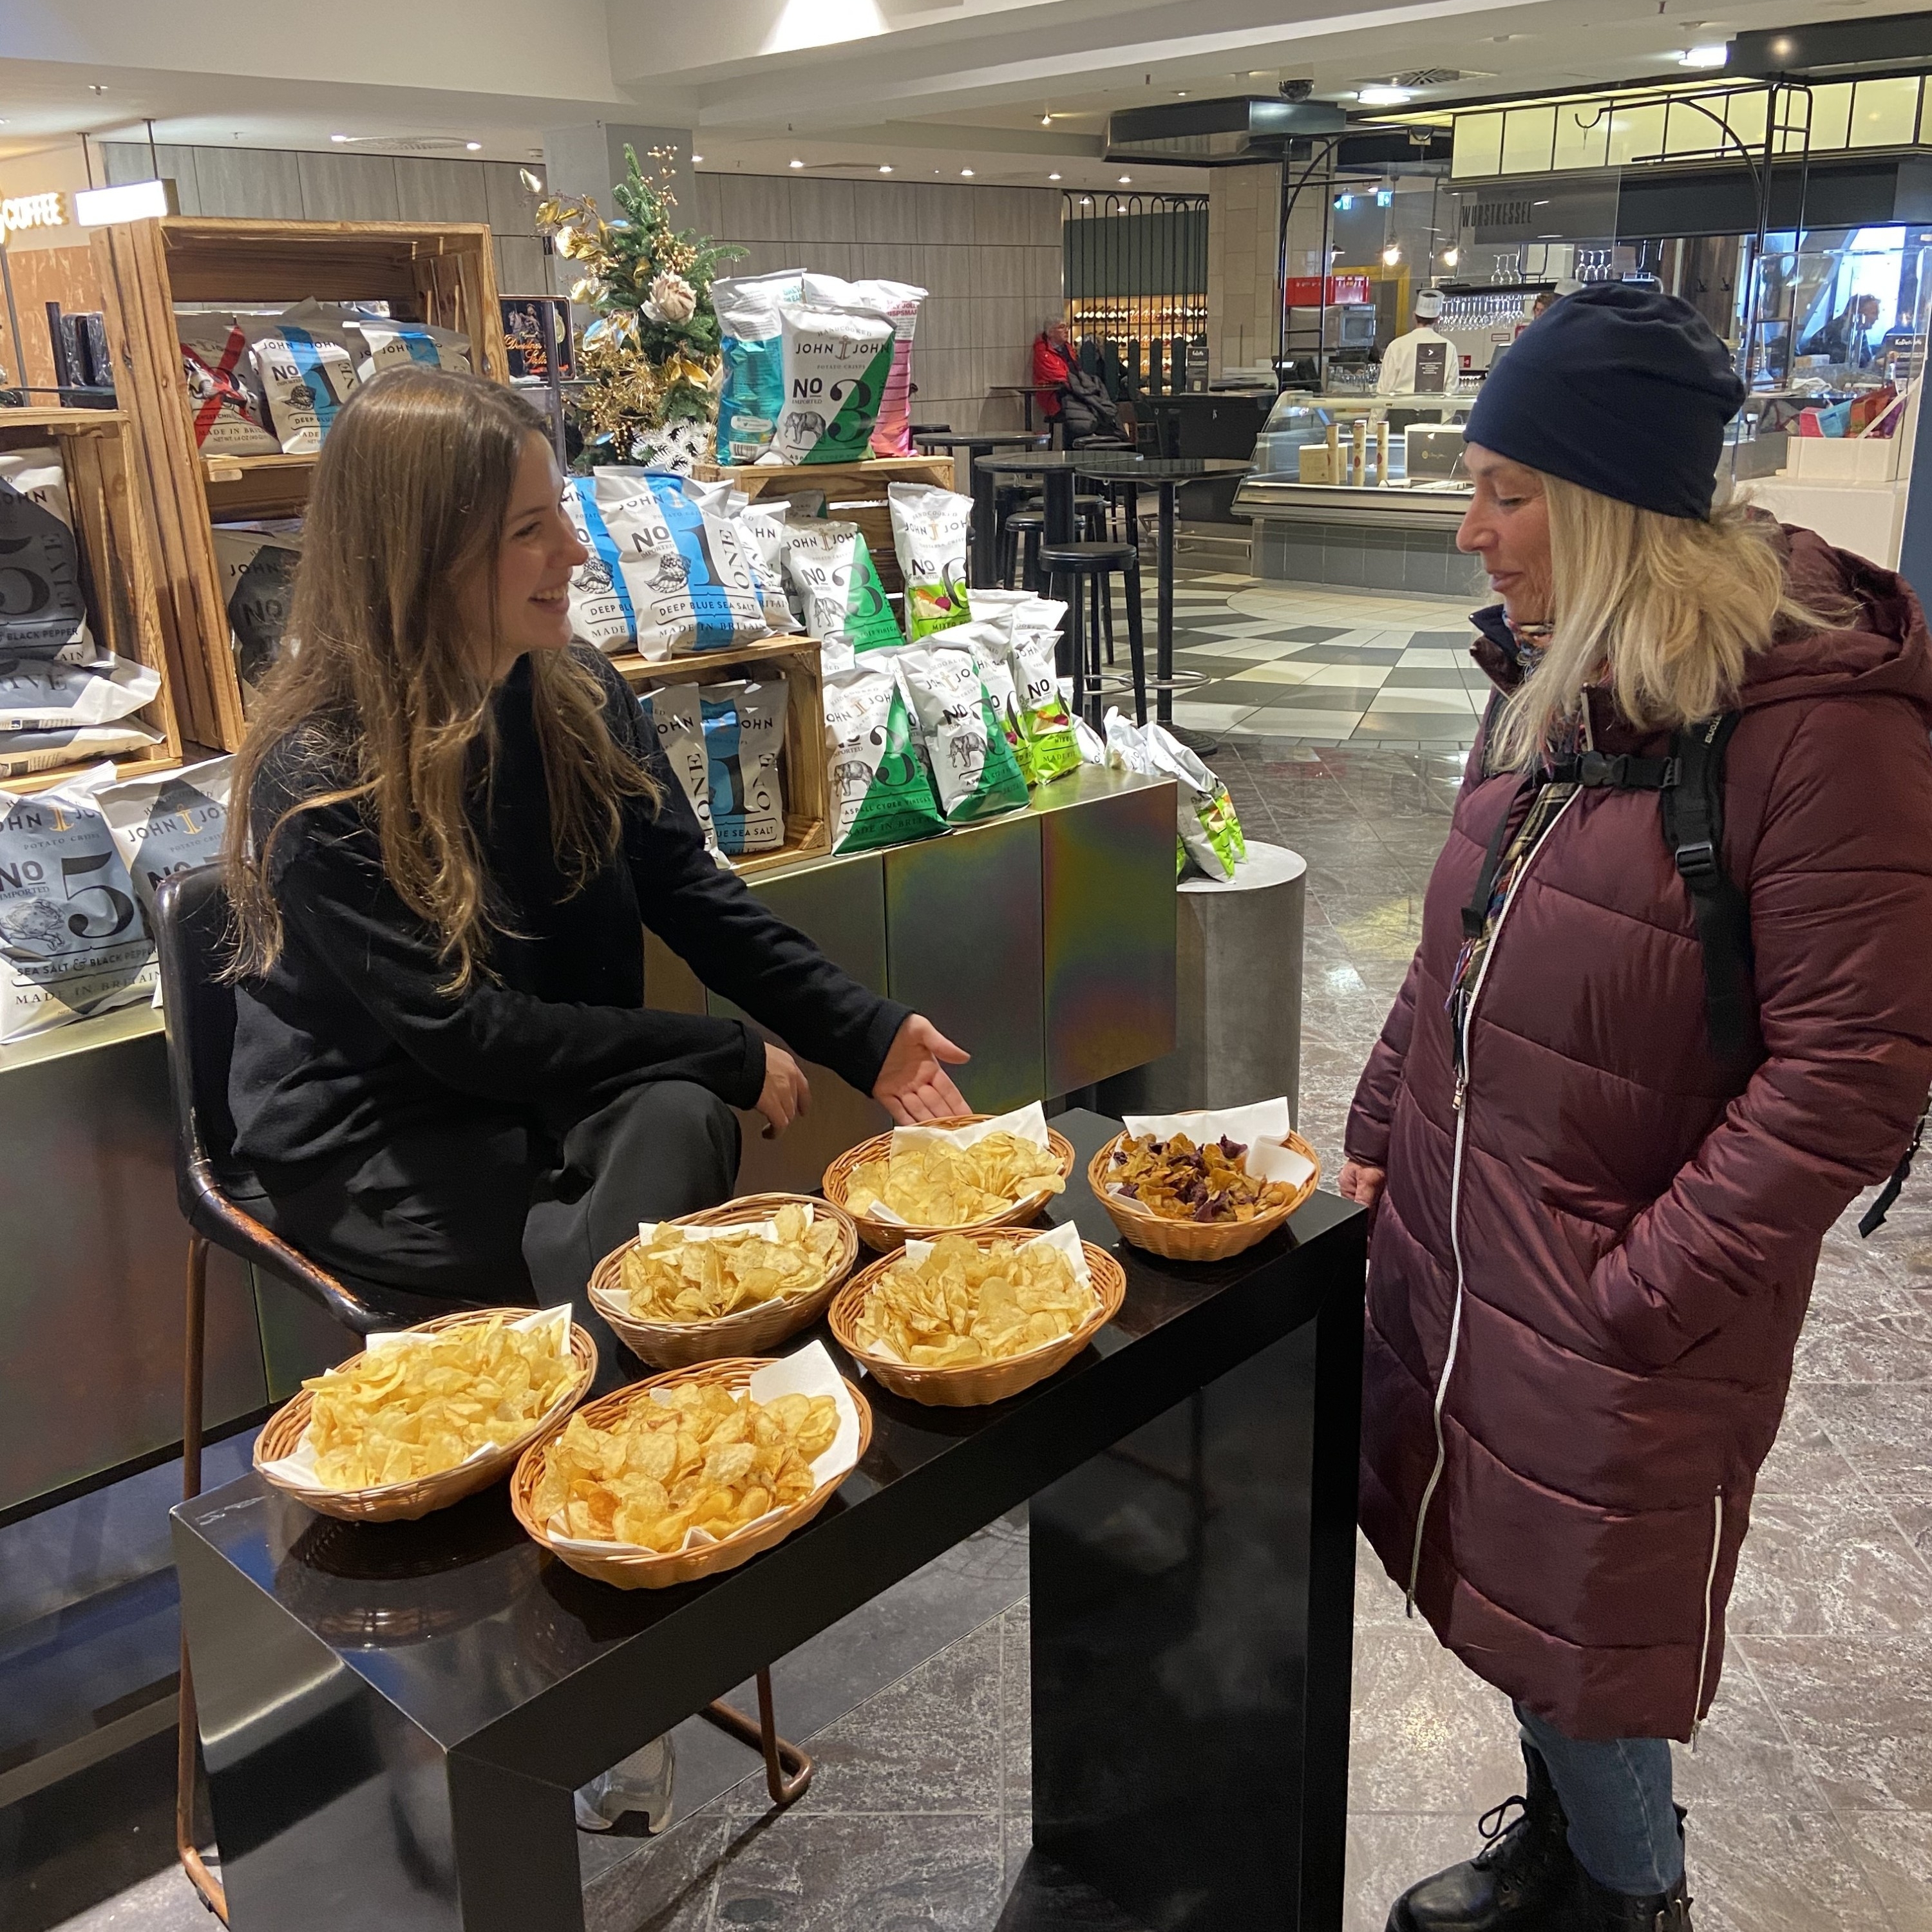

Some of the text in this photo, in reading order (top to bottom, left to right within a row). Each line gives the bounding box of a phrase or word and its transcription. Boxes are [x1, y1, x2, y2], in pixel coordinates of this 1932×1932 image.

[1462, 200, 1532, 227] WURSTKESSEL
[817, 326, 872, 337] HANDCOOKED
[382, 344, 413, 354] JOHN
[795, 343, 889, 354] JOHN JOHN
[828, 379, 872, 443] 3
[3, 490, 47, 504] OHN
[619, 494, 664, 510] JOHN
[905, 522, 927, 535] JOHN
[641, 544, 675, 558] IMPORTED
[786, 537, 817, 551] JOHN
[678, 524, 737, 589] 1
[719, 529, 750, 589] ONE
[832, 563, 883, 618] 3
[590, 603, 634, 616] DEEP BLU
[659, 603, 685, 616] DEEP
[737, 601, 755, 611] SALT
[592, 625, 626, 638] MADE
[659, 621, 765, 638] MADE IN BRITAIN
[933, 621, 956, 631] MIXED
[7, 627, 78, 641] BLACK PEPPER
[826, 711, 852, 722] OHN
[657, 717, 694, 734] OHN
[870, 725, 915, 786] 3
[687, 753, 710, 821] ONE
[844, 805, 874, 815] ASPALL
[876, 801, 902, 810] CYDER
[128, 819, 178, 842] JOHN
[754, 826, 773, 835] SALT
[880, 821, 893, 831] IN
[24, 838, 64, 850] POTATO
[170, 840, 201, 852] POTATO
[1, 886, 50, 900] IMPORTED
[61, 851, 135, 938] 5
[17, 967, 40, 976] SEA
[43, 963, 69, 974] SALT
[73, 958, 88, 971] &
[90, 954, 121, 967] BLACK
[15, 990, 65, 1005] MADE
[75, 986, 91, 996] IN
